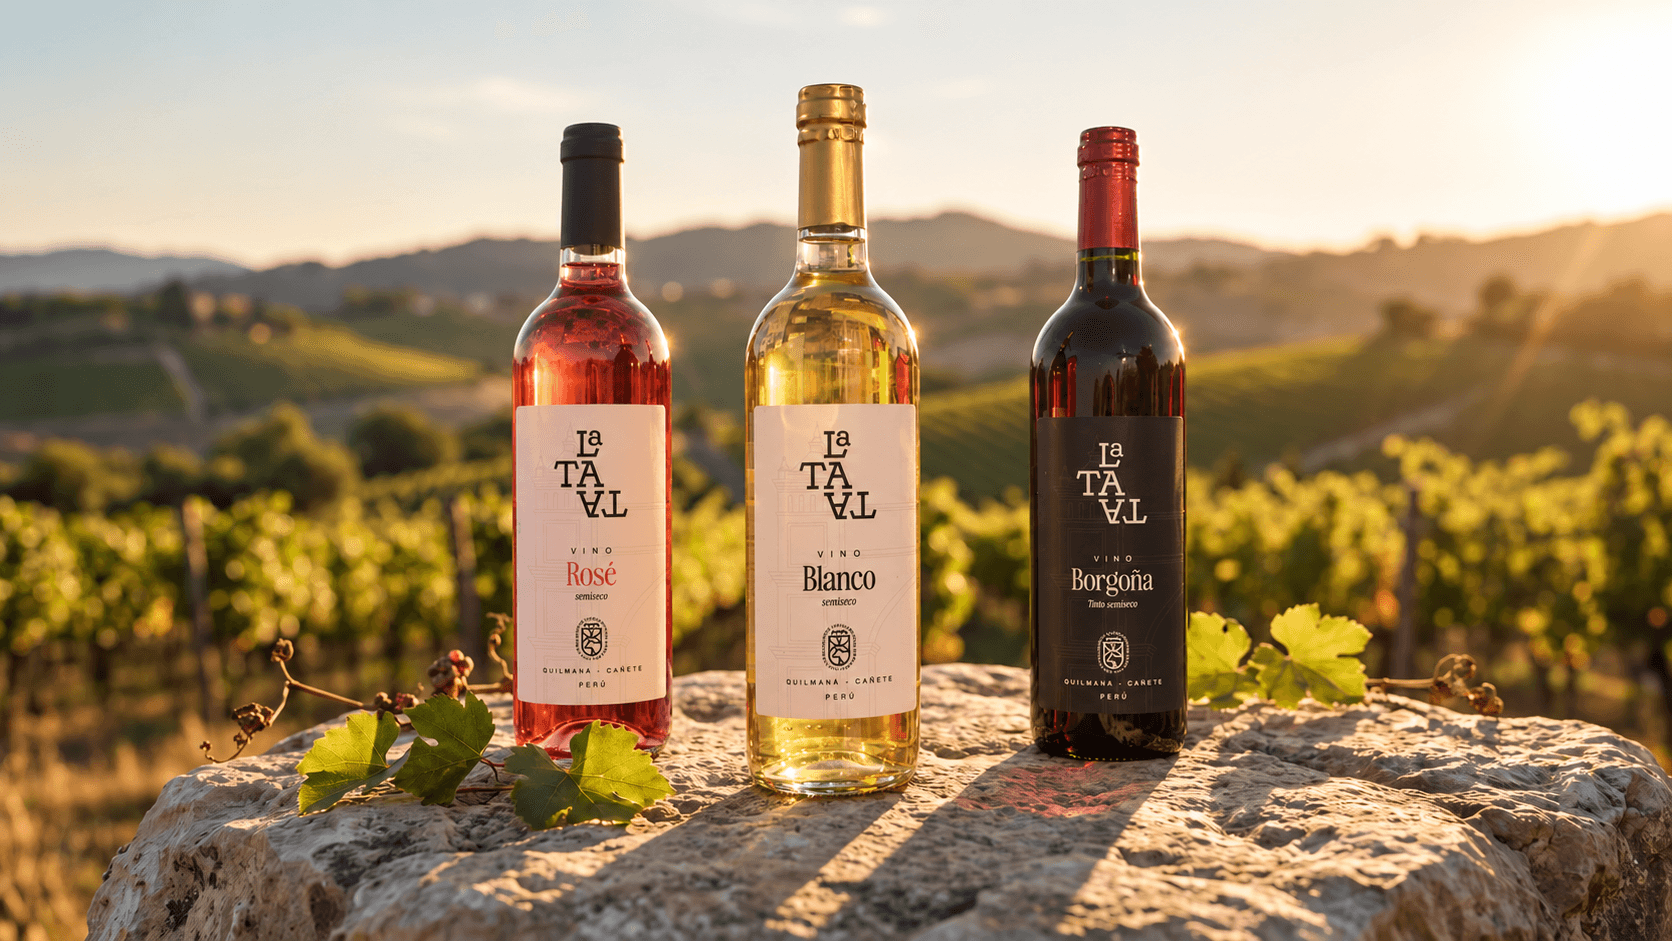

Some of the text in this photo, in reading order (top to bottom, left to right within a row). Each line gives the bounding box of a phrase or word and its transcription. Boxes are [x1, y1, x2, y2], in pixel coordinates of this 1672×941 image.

[576, 430, 603, 458] La
[823, 430, 851, 459] La
[1098, 442, 1124, 468] La
[554, 460, 605, 488] TA
[799, 461, 853, 490] TA
[1076, 470, 1126, 496] TA
[570, 547, 612, 555] VINO
[817, 549, 861, 558] VINO
[1093, 555, 1133, 563] VINO
[566, 561, 617, 587] Rosé
[802, 565, 876, 592] Blanco
[1071, 567, 1154, 597] Borgoña
[575, 591, 609, 601] semiseco
[821, 597, 857, 607] semiseco
[1087, 599, 1138, 608] Tinto semiseco
[578, 680, 606, 688] PERÚ
[855, 675, 893, 685] CAÑETE
[1127, 678, 1163, 686] CAÑETE
[825, 692, 855, 701] PERÚ
[1099, 691, 1127, 700] PERÚ
